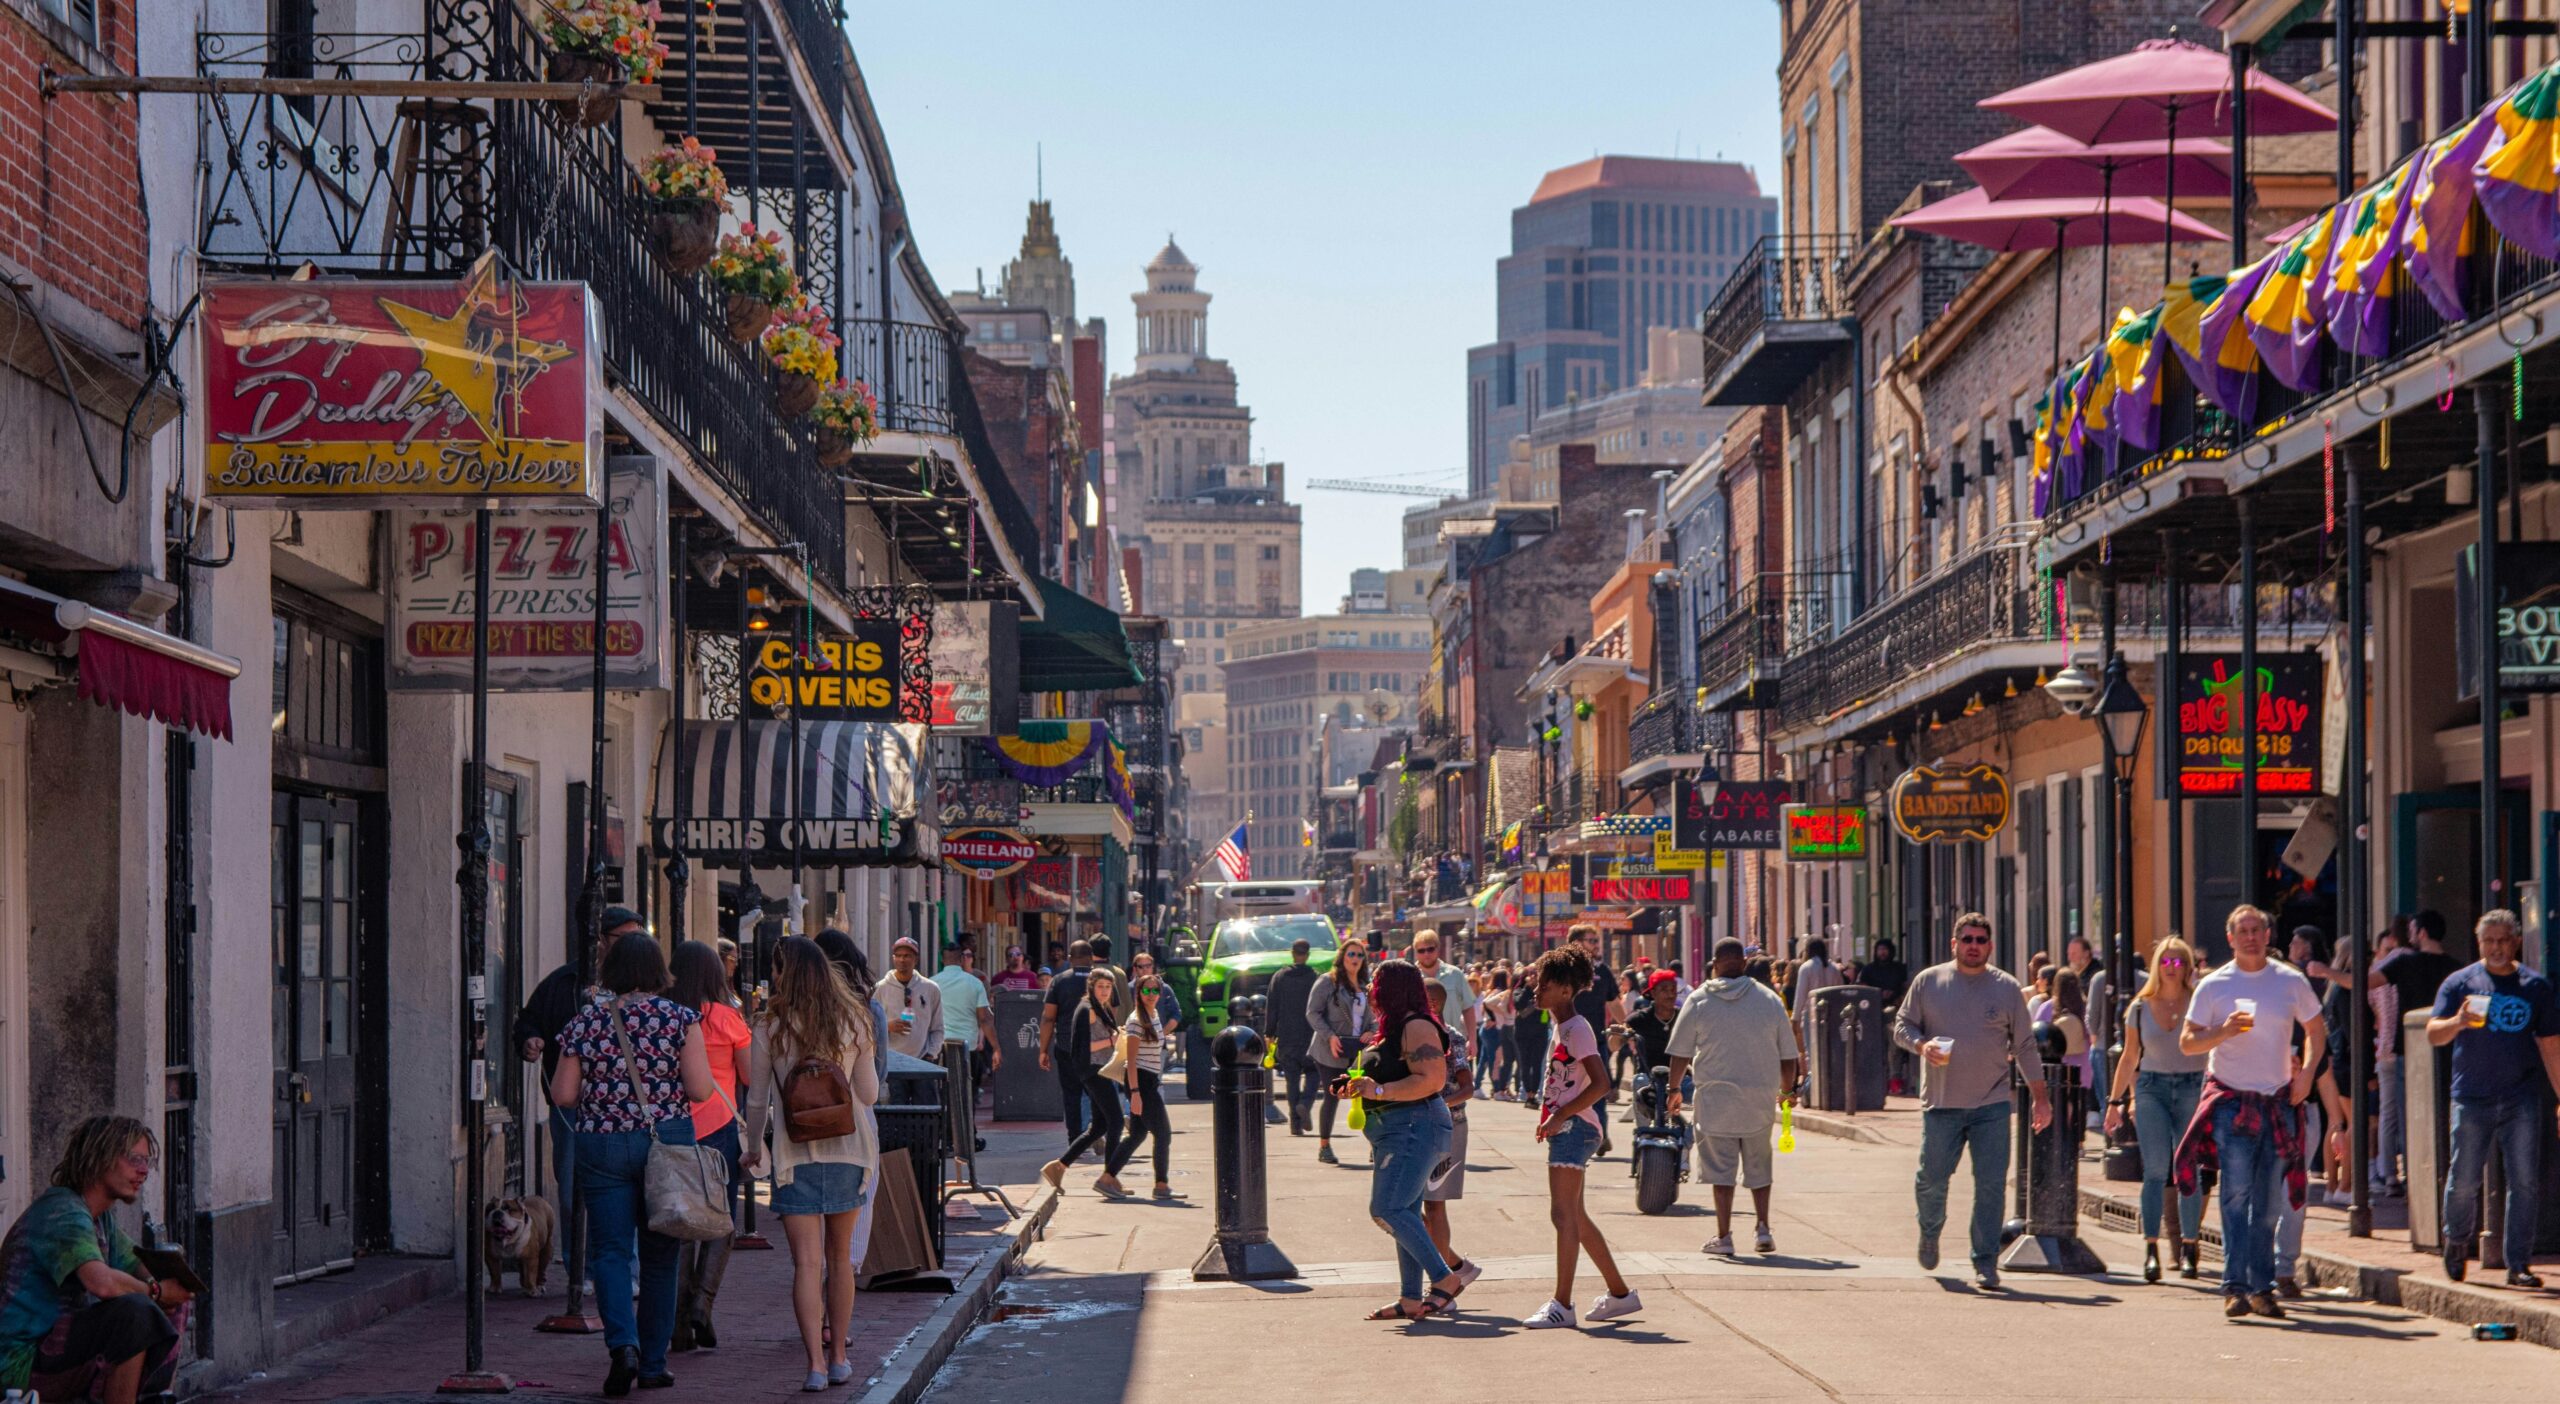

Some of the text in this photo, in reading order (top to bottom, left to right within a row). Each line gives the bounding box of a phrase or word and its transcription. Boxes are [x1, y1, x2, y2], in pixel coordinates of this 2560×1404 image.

[237, 295, 368, 378] Big
[217, 370, 467, 454] Daddy's
[220, 447, 579, 490] Bottomless Topless
[408, 521, 641, 582] PIZZA
[415, 624, 634, 652] PIZZA BY THE SLCE
[750, 676, 893, 708] OWENS
[2180, 692, 2230, 733] BIG
[1686, 804, 1781, 820] SUTR
[1903, 792, 2004, 817] BANDSTAND
[662, 820, 766, 850] CHRIS
[780, 820, 901, 850] OWENS
[941, 841, 1035, 859] DIXIELAND
[978, 869, 993, 878] ATM
[1632, 877, 1663, 900] LEGAL
[1664, 876, 1690, 899] CLUB
